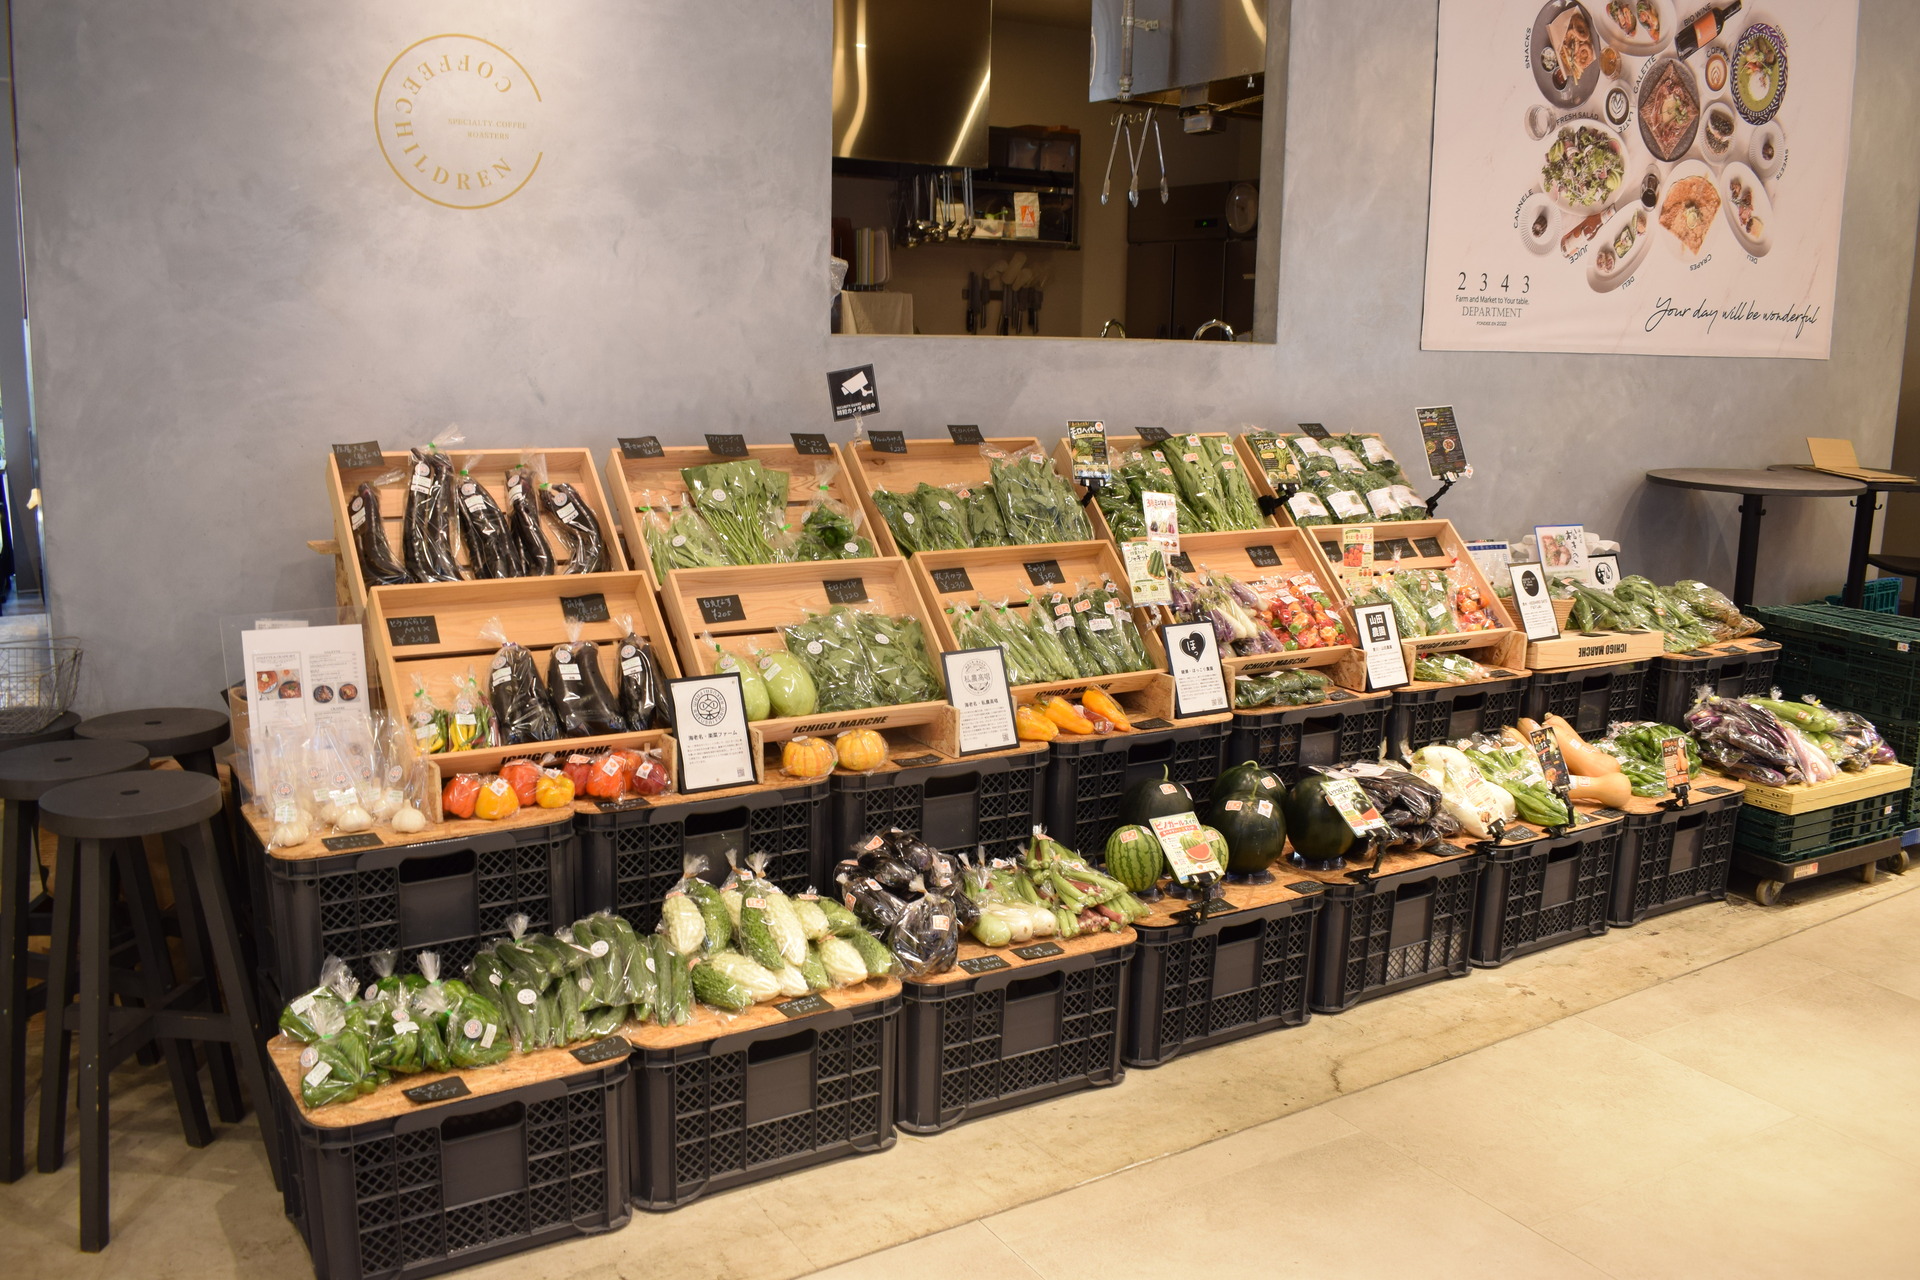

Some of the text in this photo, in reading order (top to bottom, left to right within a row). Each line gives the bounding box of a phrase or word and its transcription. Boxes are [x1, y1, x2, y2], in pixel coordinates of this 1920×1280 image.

[1684, 3, 1712, 26] BIO WINE
[1775, 25, 1788, 48] CURRY
[1633, 54, 1656, 94] GALETTE
[395, 55, 512, 190] COFFEE CHILDREN
[448, 118, 527, 129] SPECIALTY COFFEE
[1556, 112, 1599, 125] FRESH SALAD
[1618, 112, 1633, 133] LATTE
[467, 131, 509, 140] ROASTERS
[1776, 149, 1788, 181] SWEETS
[1514, 188, 1534, 228] CANNELE
[1569, 244, 1588, 264] JUICE
[1747, 255, 1758, 264] DELI
[1690, 254, 1712, 271] CRAPES
[1622, 276, 1635, 290] DELI
[1462, 306, 1522, 318] DEPARTMENT
[1645, 297, 1820, 339] Your day will be wonderful
[1369, 614, 1384, 626] 山田
[404, 626, 430, 634] MIX
[1578, 643, 1627, 658] ICHIGO MARCHE
[1241, 657, 1311, 671] ICHIGO MARCHE
[1035, 688, 1071, 698] ICHIGO
[792, 715, 889, 734] ICHIGO MARCHE
